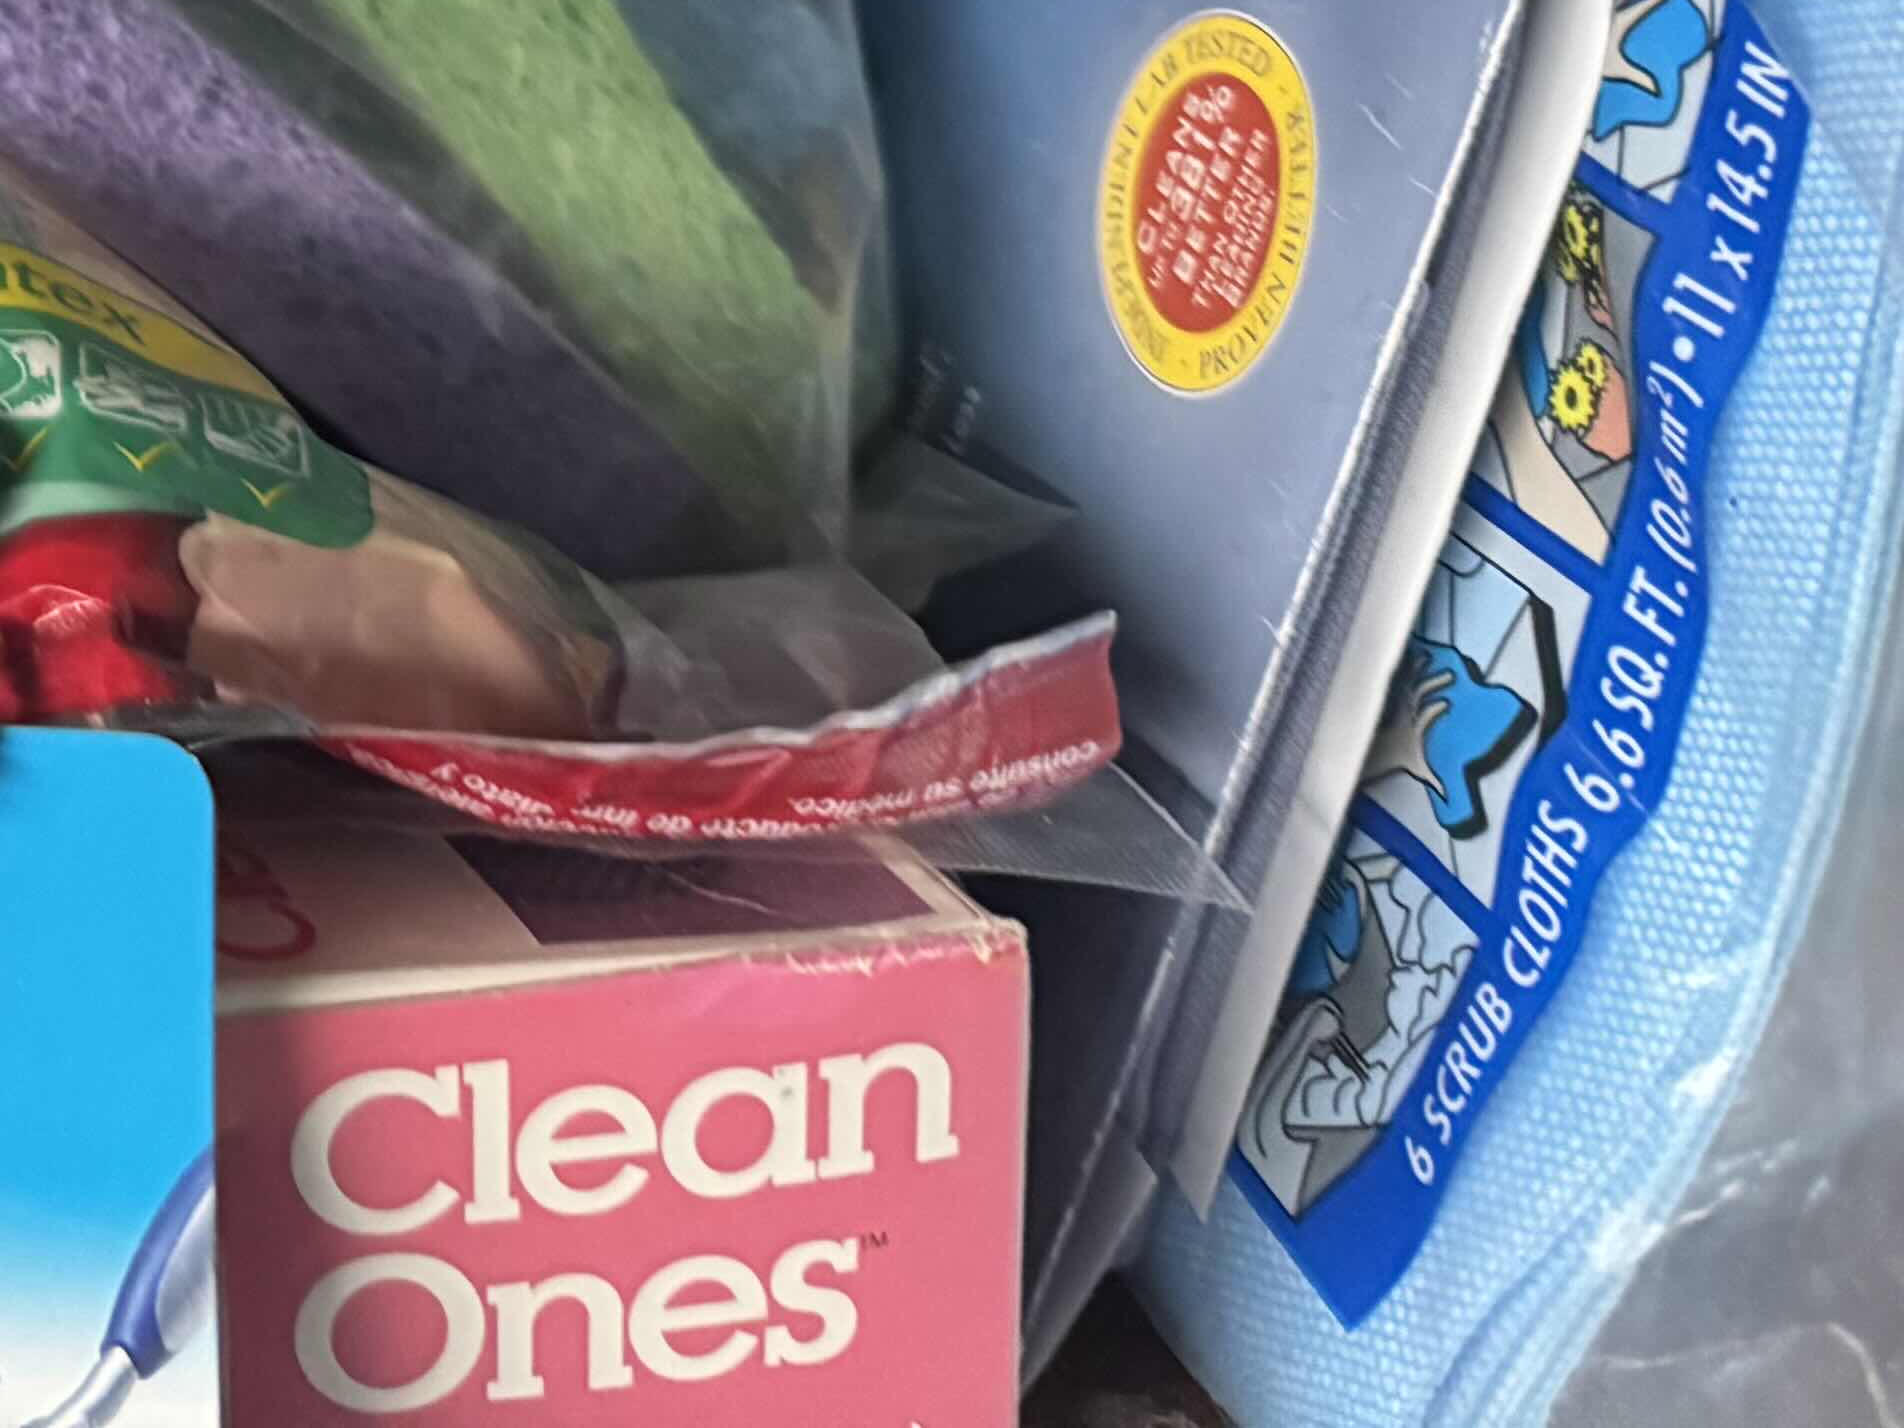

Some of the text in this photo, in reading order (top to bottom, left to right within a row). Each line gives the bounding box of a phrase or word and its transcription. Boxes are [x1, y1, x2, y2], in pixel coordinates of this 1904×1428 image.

[1740, 43, 1797, 116] IN
[1173, 126, 1243, 282] BETTER
[1705, 112, 1779, 229] 14.5
[1664, 272, 1736, 336] 11
[1709, 236, 1756, 280] x
[1648, 463, 1694, 570] (0.6
[1624, 565, 1689, 645] FT.
[1598, 642, 1671, 731] SQ.
[1562, 717, 1649, 811] 6.6
[1500, 797, 1592, 989] CLOTHS
[1419, 979, 1519, 1145] SCRUB
[290, 1037, 959, 1239] Clean
[1396, 1135, 1442, 1185] 6
